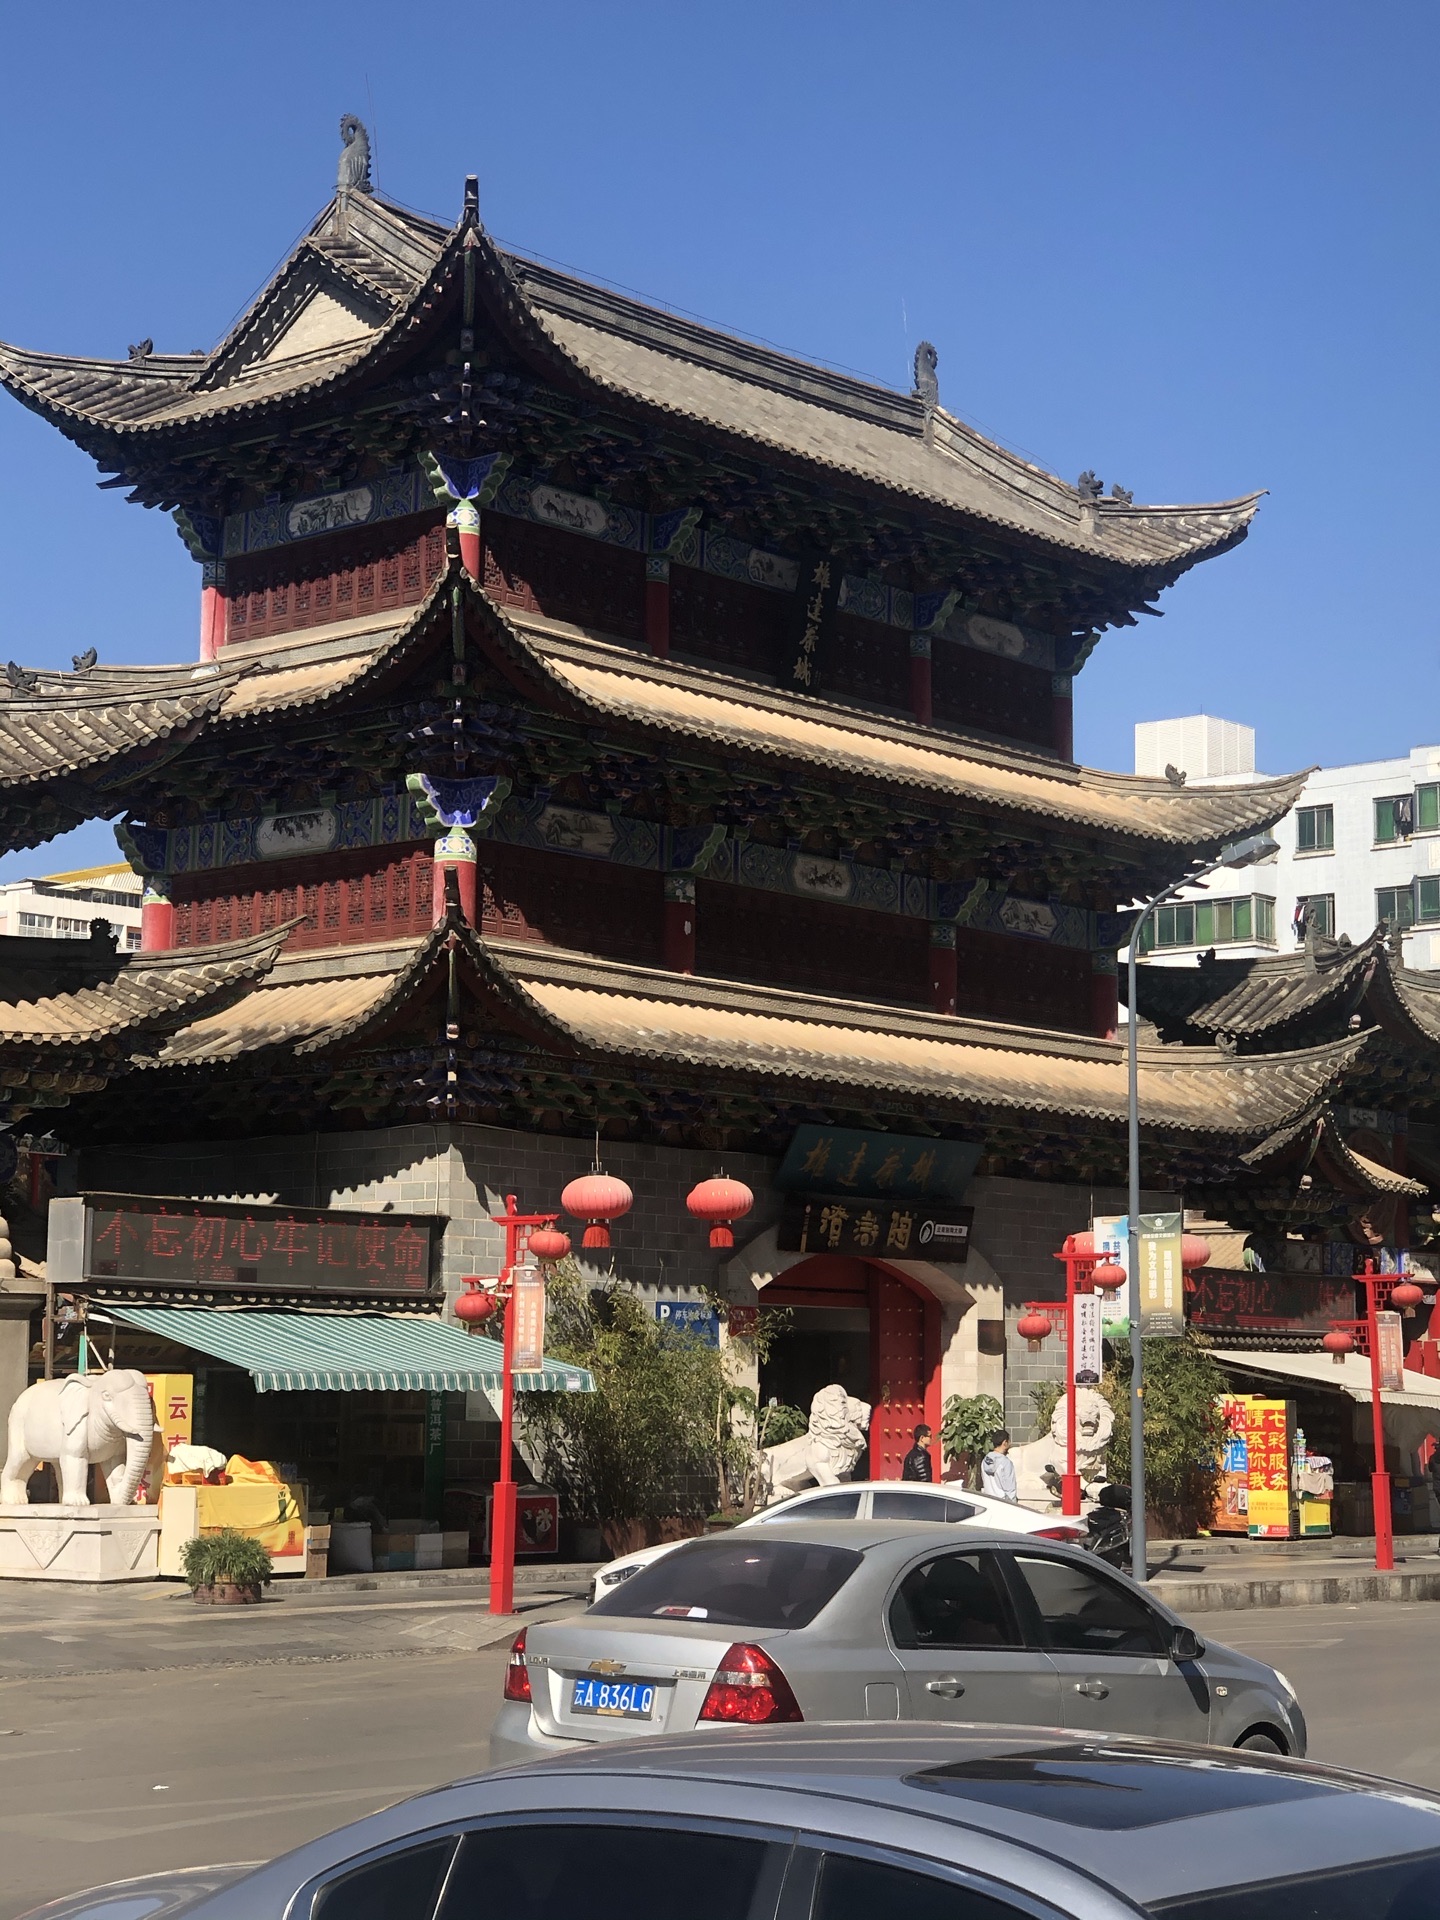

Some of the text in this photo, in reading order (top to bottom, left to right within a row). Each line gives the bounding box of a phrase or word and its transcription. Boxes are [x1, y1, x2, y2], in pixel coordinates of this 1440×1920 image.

[97, 1206, 427, 1271] 不忘初心牢记使命
[660, 1305, 671, 1322] P
[1246, 1409, 1270, 1492] 情系你我
[1267, 1410, 1288, 1491] 七彩服务
